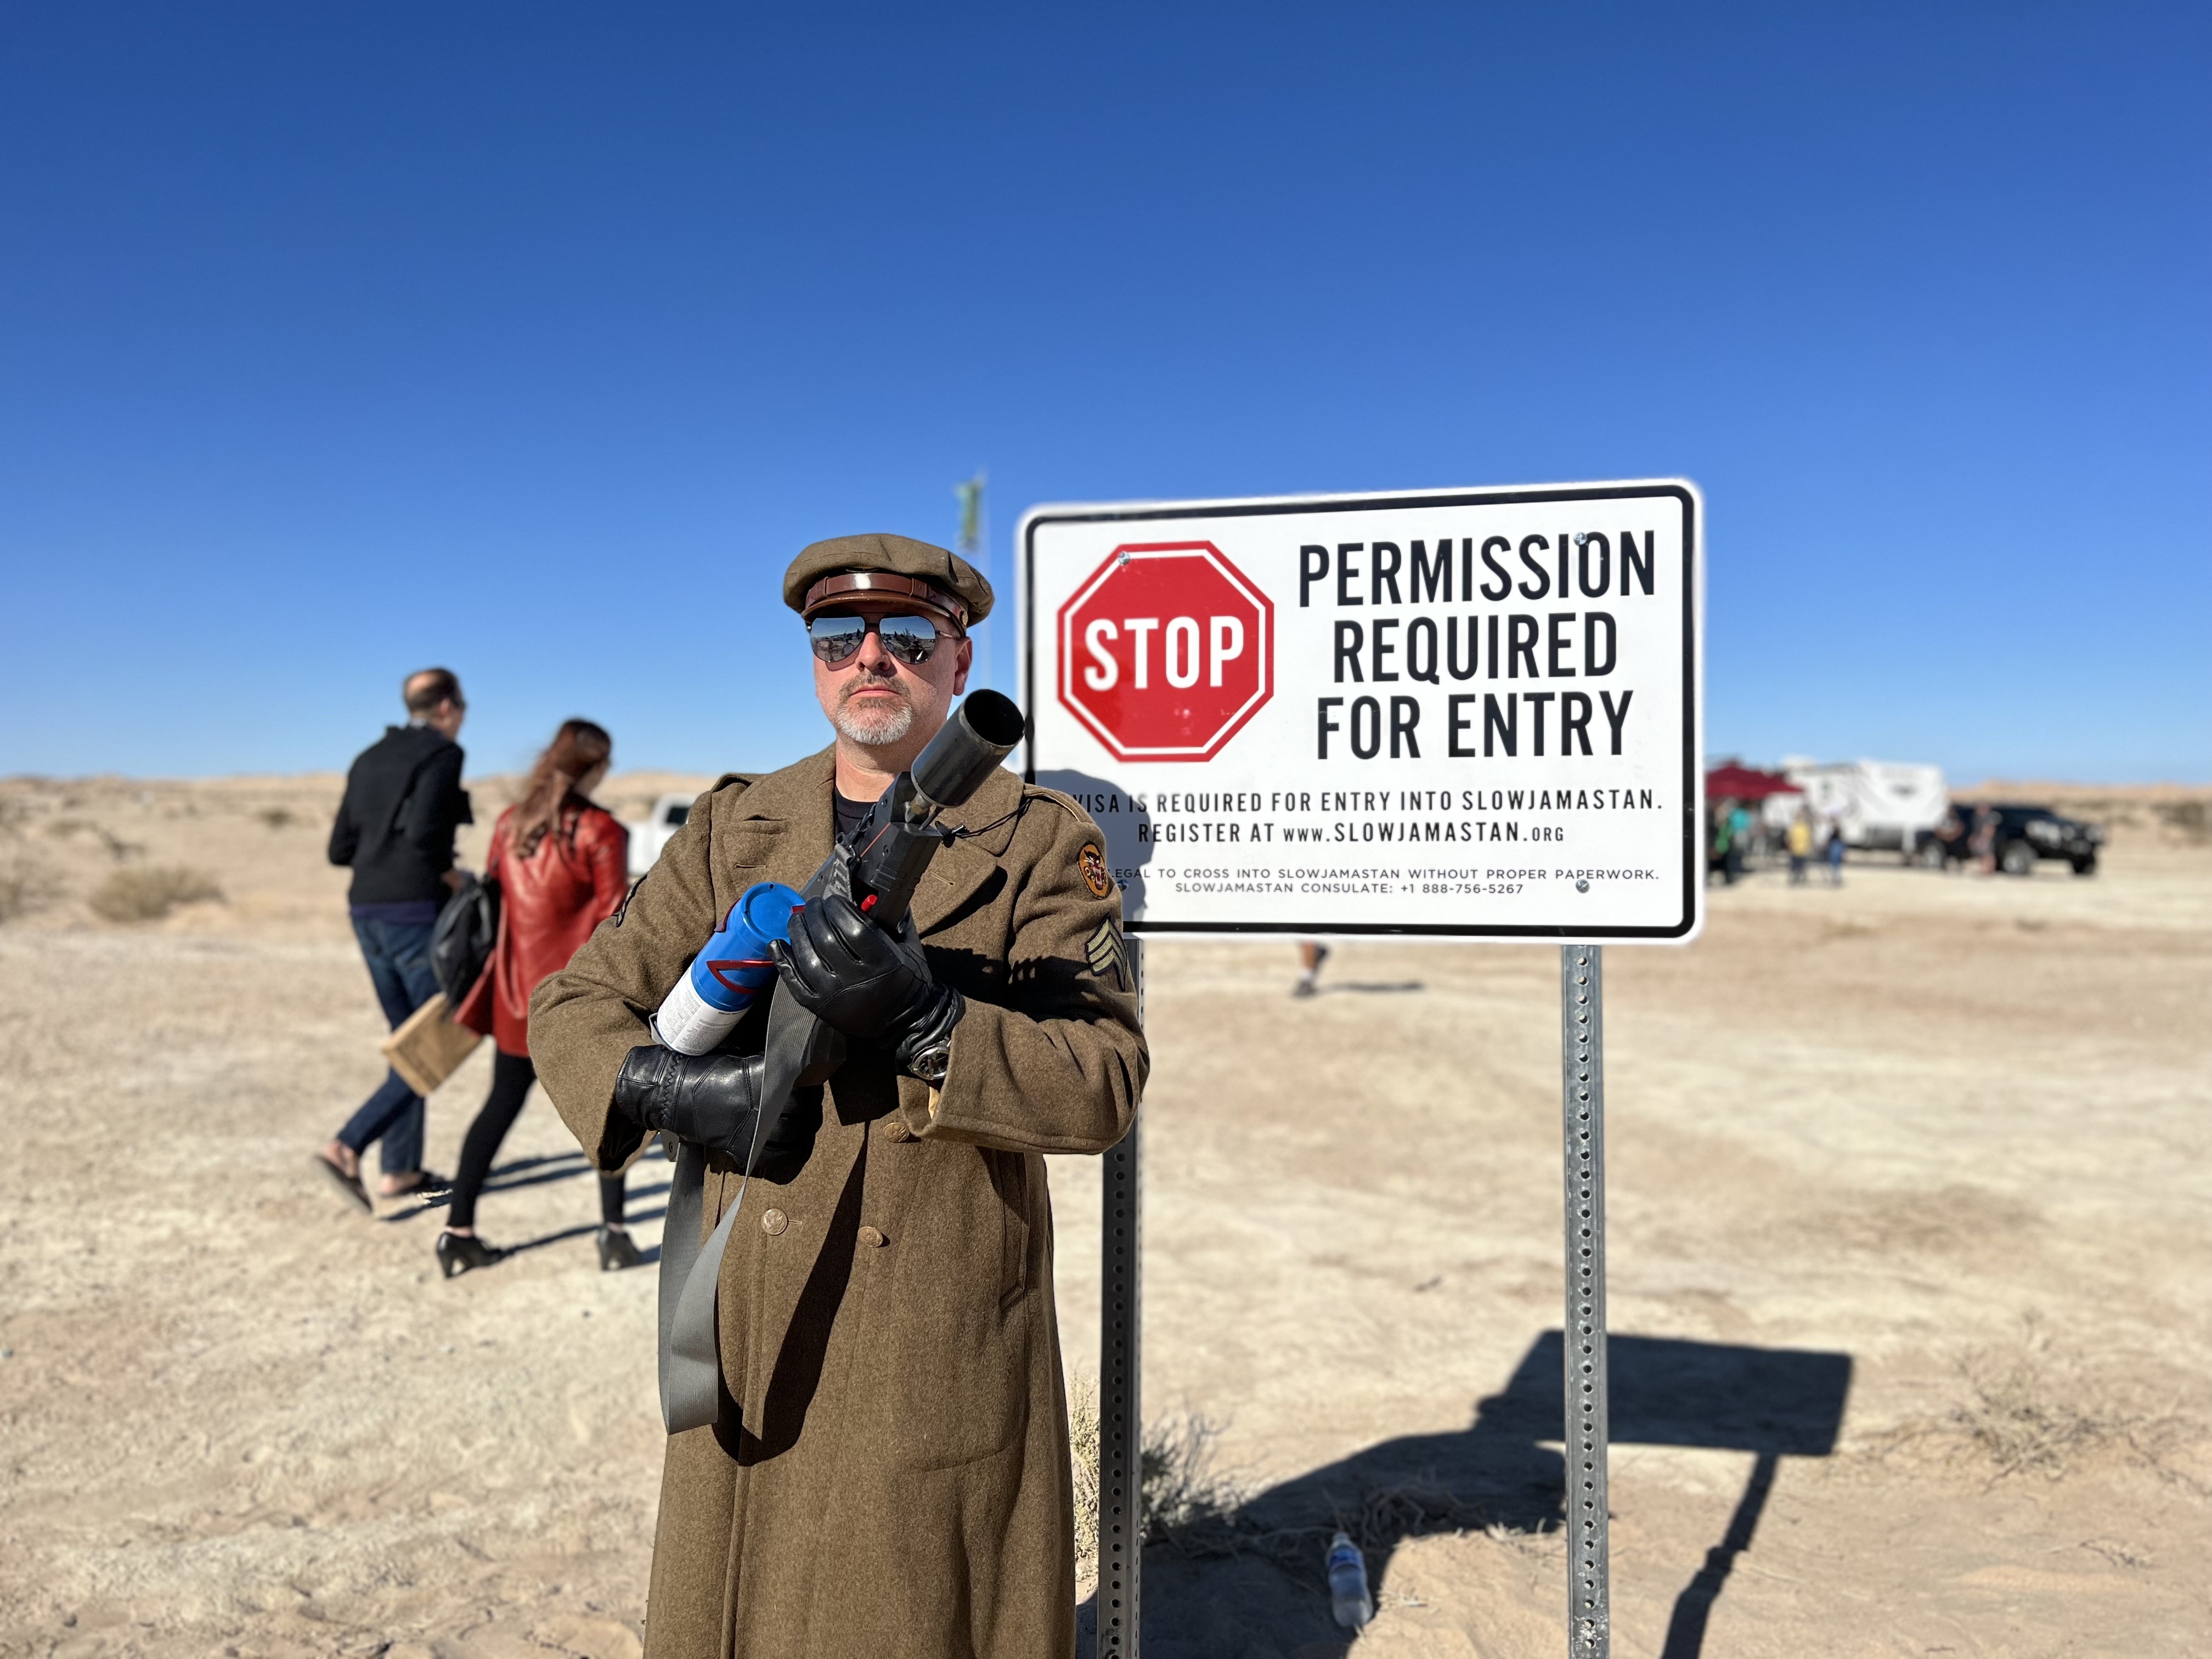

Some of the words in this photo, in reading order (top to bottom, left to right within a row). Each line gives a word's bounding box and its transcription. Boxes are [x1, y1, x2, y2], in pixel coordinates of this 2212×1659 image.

[1299, 529, 1655, 607] PERMISSION
[1084, 615, 1245, 691] STOP
[1334, 611, 1617, 685] REQUIRED
[1317, 695, 1421, 760] FOR
[1448, 690, 1634, 758] ENTRY
[1129, 793, 1147, 812] IS
[1156, 793, 1262, 814] REQUIRED
[1272, 792, 1311, 812] FOR
[1321, 792, 1391, 811] ENTRY
[1400, 791, 1452, 811] INTO
[1462, 789, 1662, 810] SLOWJAMASTAN.
[1138, 823, 1240, 843] REGISTER
[1250, 823, 1274, 842] AT
[1108, 868, 1150, 878] EGAL
[1158, 868, 1176, 878] TO
[1183, 868, 1229, 878] CROSS
[1237, 868, 1271, 878] INTO
[1278, 869, 1400, 879] SLOWJAMASTAN
[1408, 869, 1479, 879] WITHOUT
[1486, 869, 1547, 879] PROPER
[1555, 869, 1659, 879] PAPERWORK.
[1175, 883, 1294, 893] SLOWJAMASTAN
[1300, 883, 1393, 893] CONSULATE:
[1401, 883, 1414, 893] +1
[1422, 883, 1524, 894] 888-756-5267
